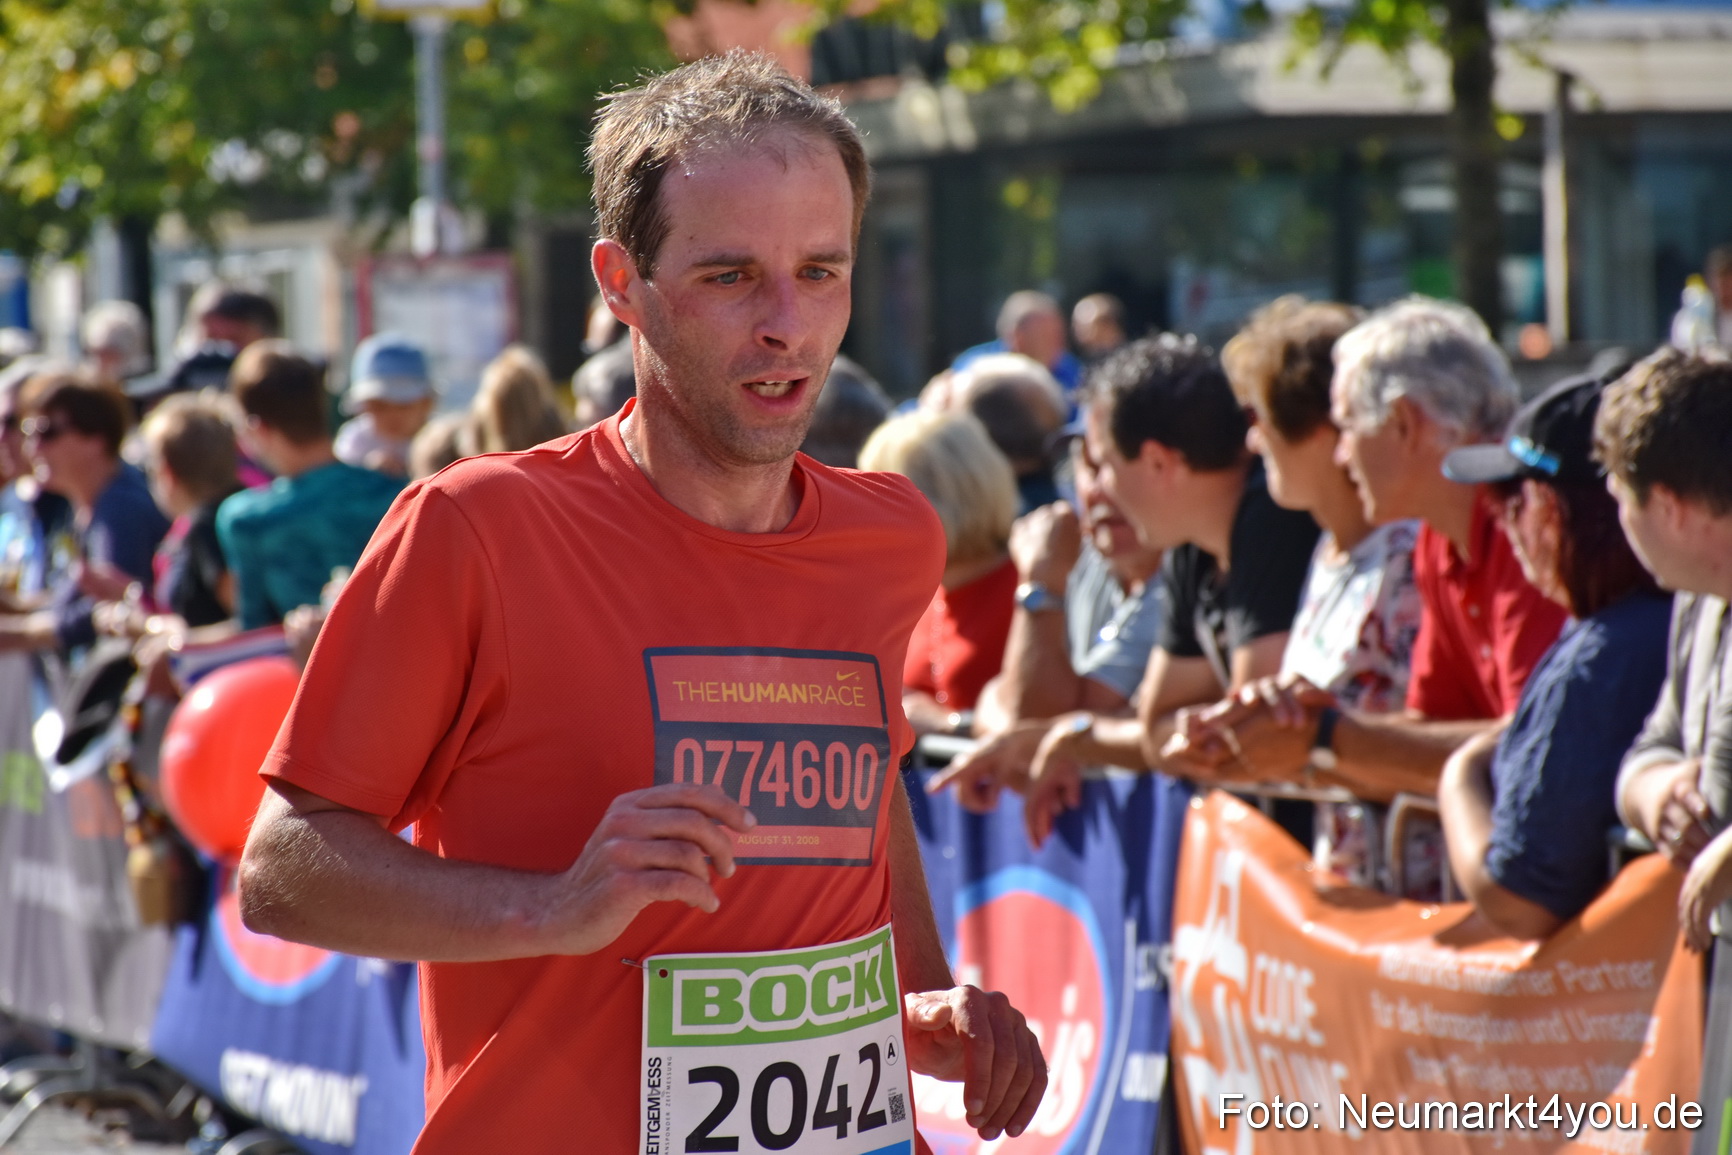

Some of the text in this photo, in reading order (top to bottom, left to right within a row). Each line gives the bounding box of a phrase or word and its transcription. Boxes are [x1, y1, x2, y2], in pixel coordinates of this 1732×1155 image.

[673, 737, 879, 811] 0774600
[737, 835, 820, 847] AUGUST 31, 2008
[673, 944, 888, 1035] BOCK
[887, 1042, 896, 1060] A
[684, 1042, 888, 1154] 2042
